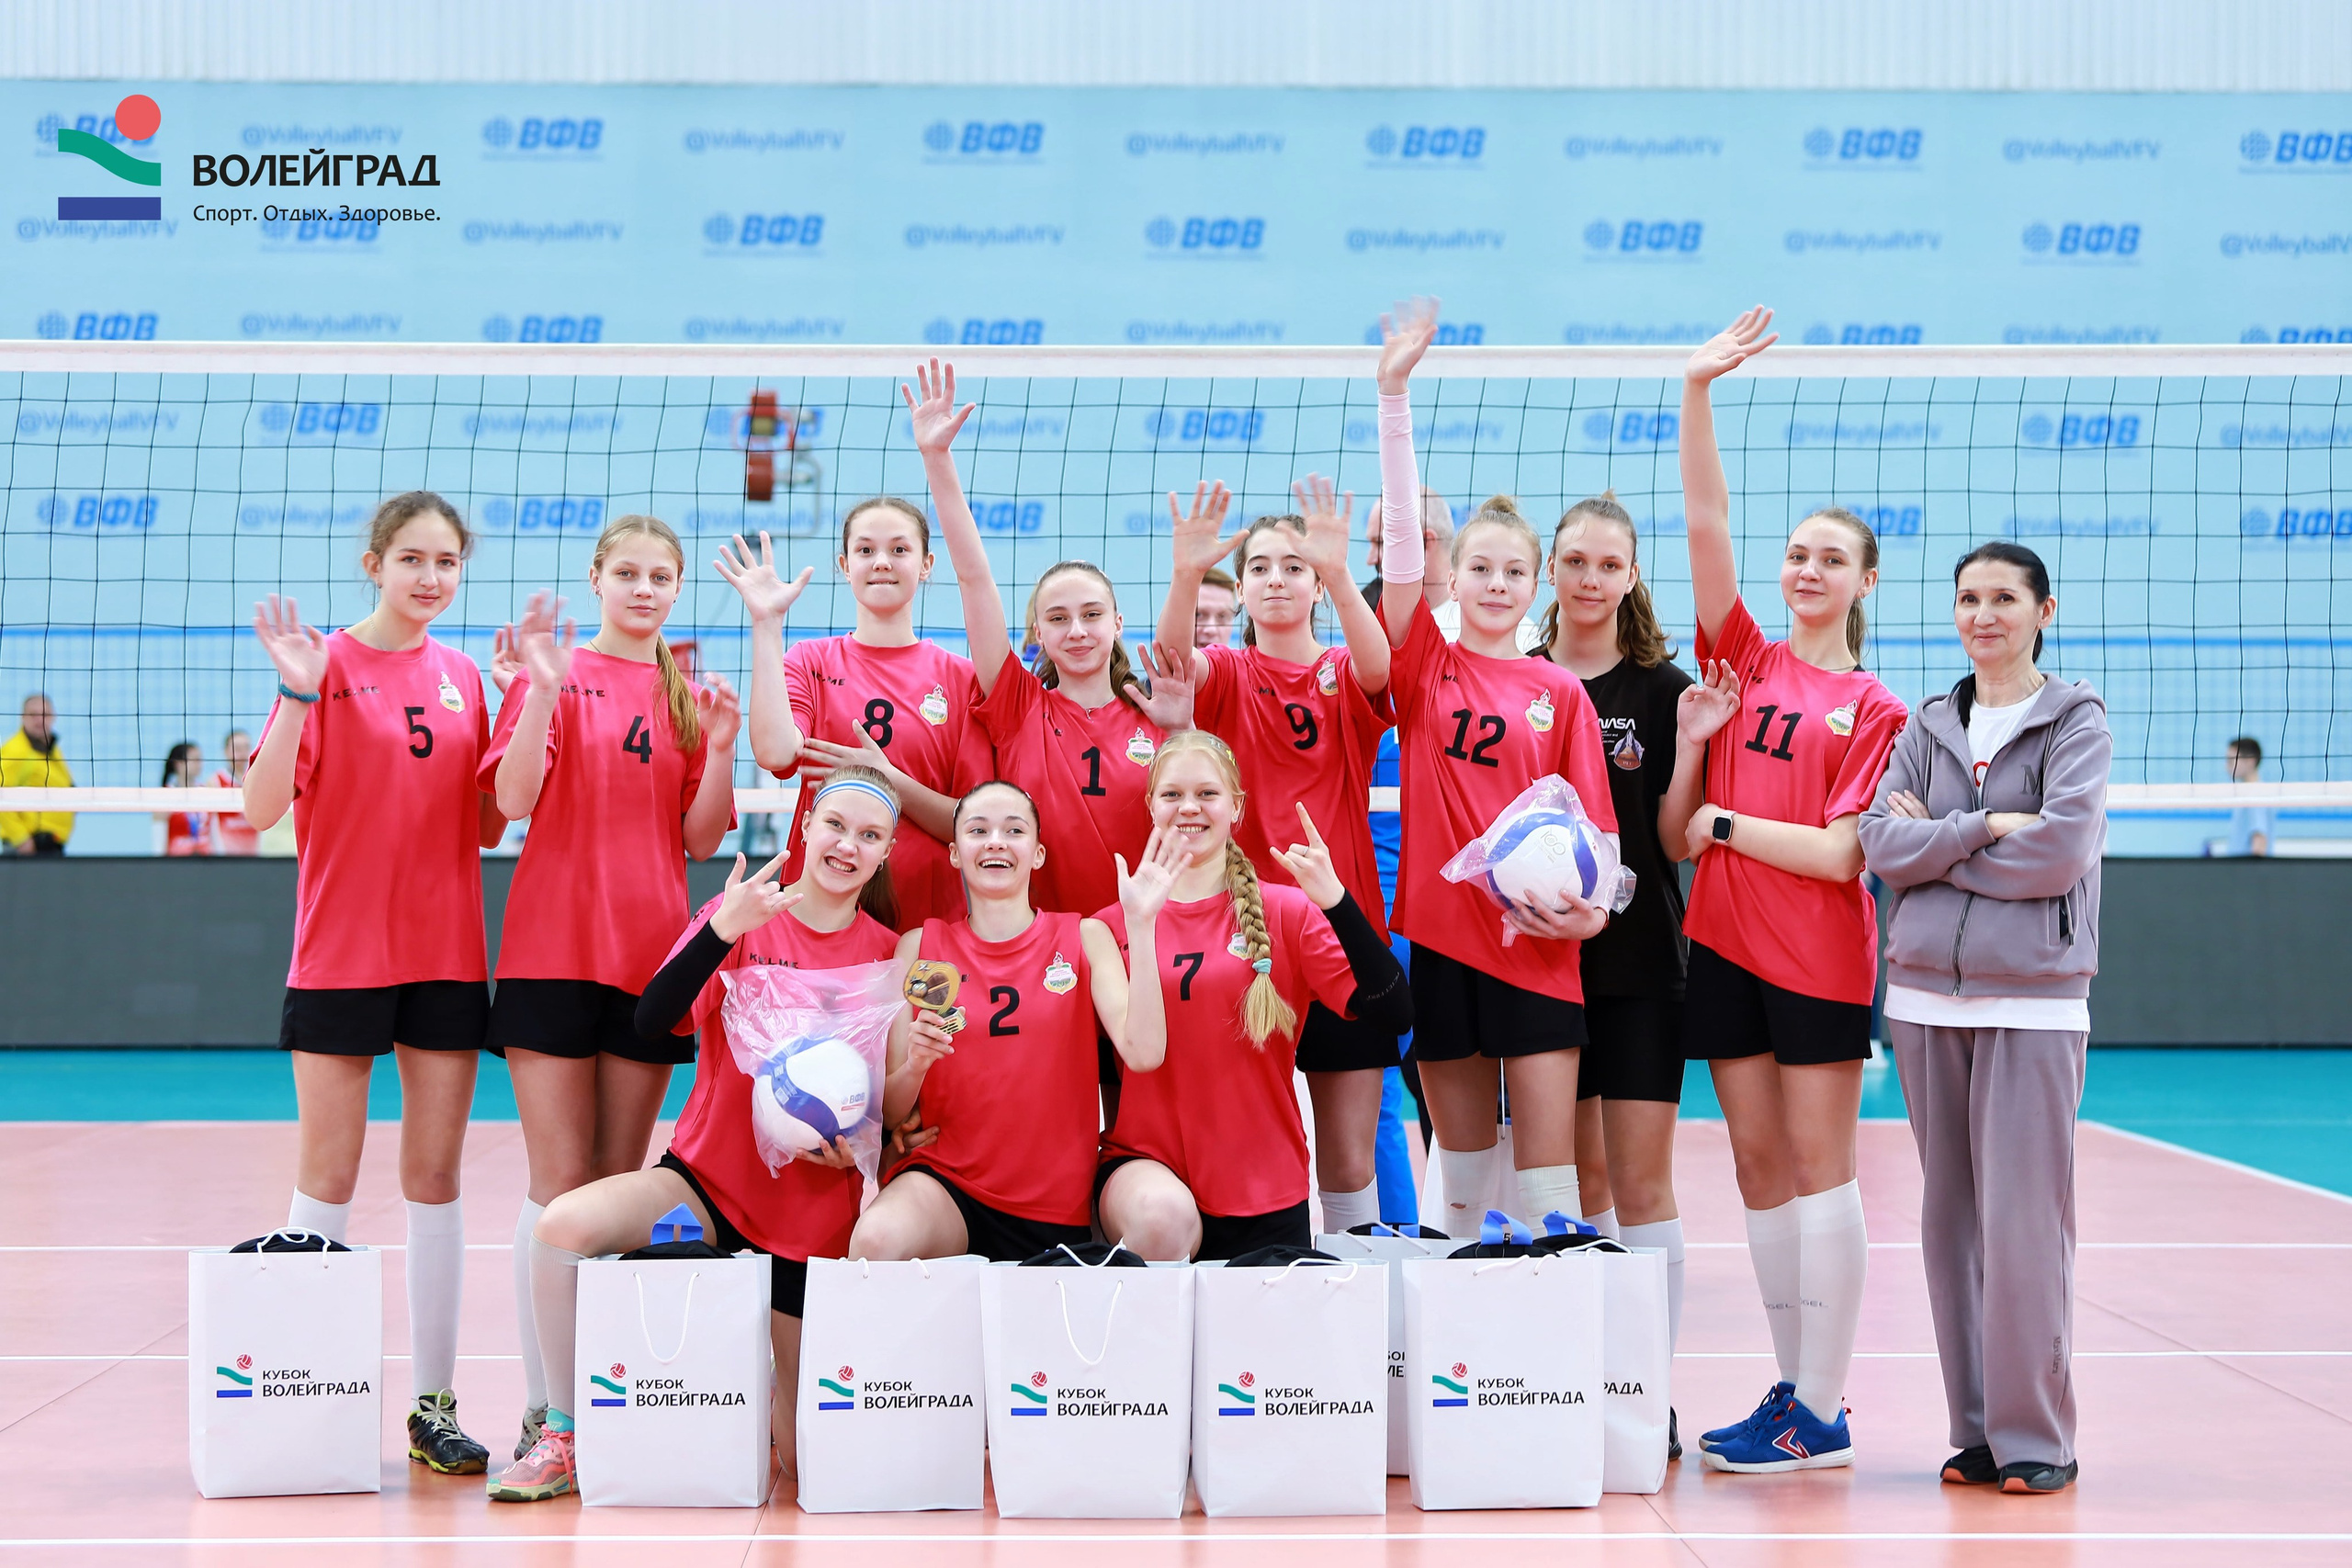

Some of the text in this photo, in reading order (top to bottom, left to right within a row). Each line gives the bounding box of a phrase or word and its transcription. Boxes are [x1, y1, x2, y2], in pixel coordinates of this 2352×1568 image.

[862, 698, 894, 750] 8
[1283, 703, 1318, 750] 9
[1598, 717, 1636, 731] NASA
[406, 706, 433, 759] 5
[622, 716, 652, 764] 4
[1444, 708, 1507, 768] 12
[1744, 704, 1802, 762] 11
[1080, 746, 1106, 796] 1
[1172, 951, 1205, 1002] 7
[989, 986, 1020, 1038] 2
[263, 1369, 311, 1381] КУБОК
[262, 1381, 370, 1397] ВОЛЕЙГРАДА
[636, 1379, 684, 1389] КУБОК
[864, 1381, 912, 1392] КУБОК
[1477, 1378, 1525, 1389] КУБОК
[636, 1392, 746, 1407] ВОЛЕЙГРАДА
[1057, 1388, 1106, 1399] КУБОК
[1265, 1388, 1314, 1398] КУБОК
[1477, 1391, 1585, 1406] ВОЛЕЙГРАДА
[864, 1393, 974, 1409] ВОЛЕЙГРАДА
[1057, 1401, 1169, 1416] ВОЛЕЙГРАДА
[1265, 1401, 1374, 1416] ВОЛЕЙГРАДА
